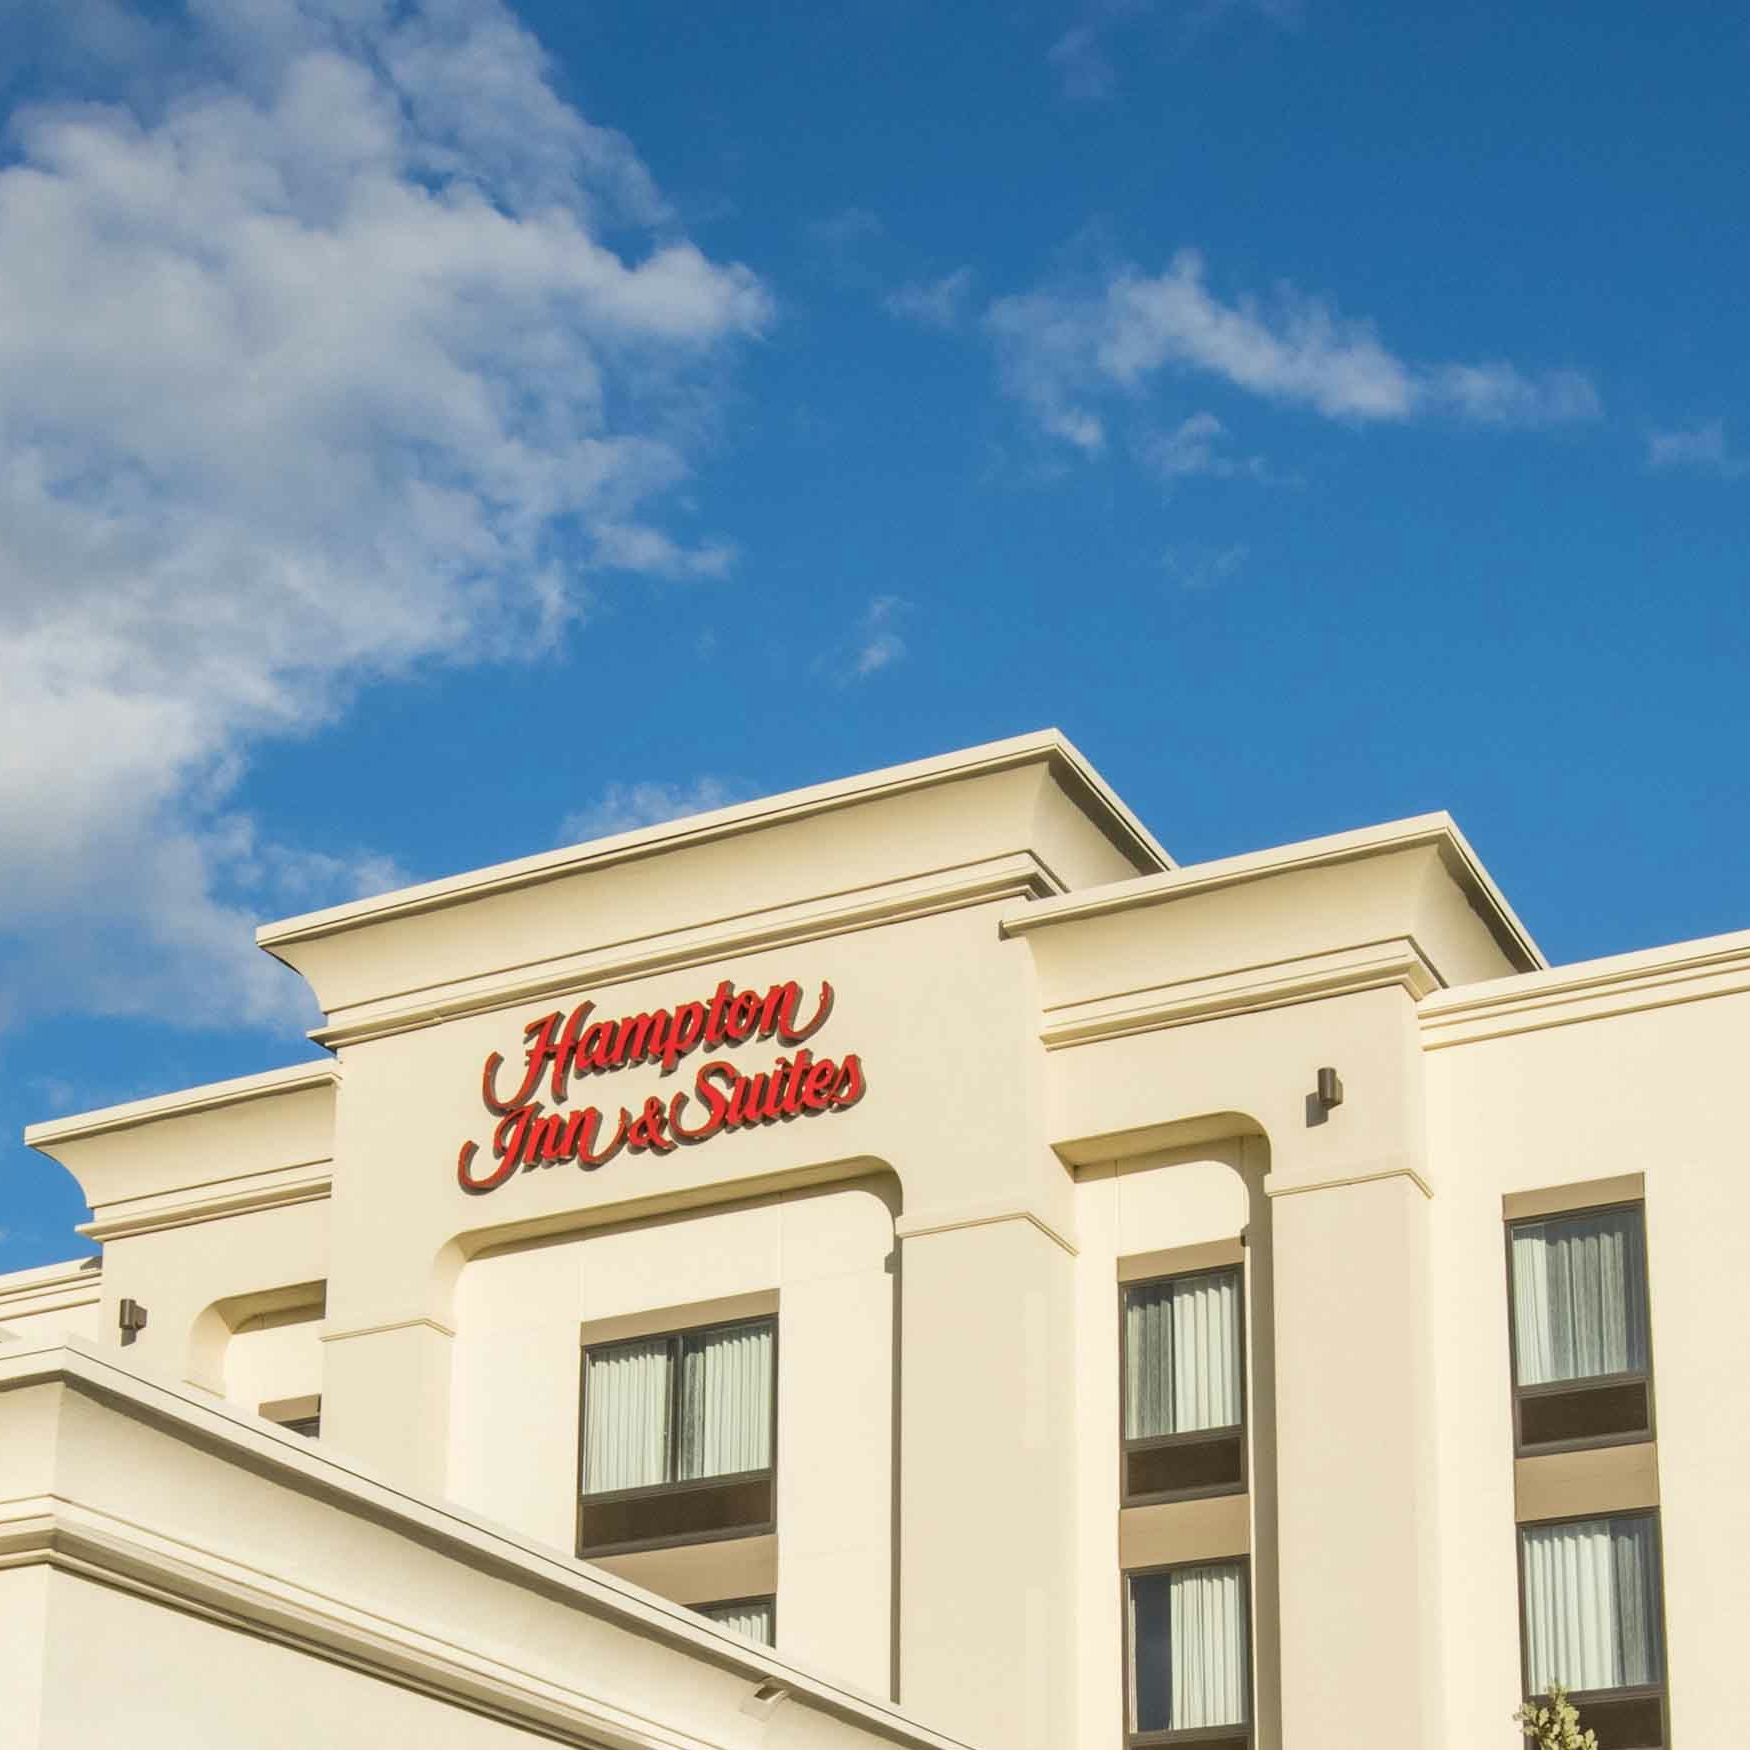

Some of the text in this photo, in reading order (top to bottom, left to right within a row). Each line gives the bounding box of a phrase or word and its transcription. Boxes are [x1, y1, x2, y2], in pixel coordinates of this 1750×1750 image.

[482, 979, 832, 1111] Hampton
[457, 1047, 865, 1191] Inn & Suites
